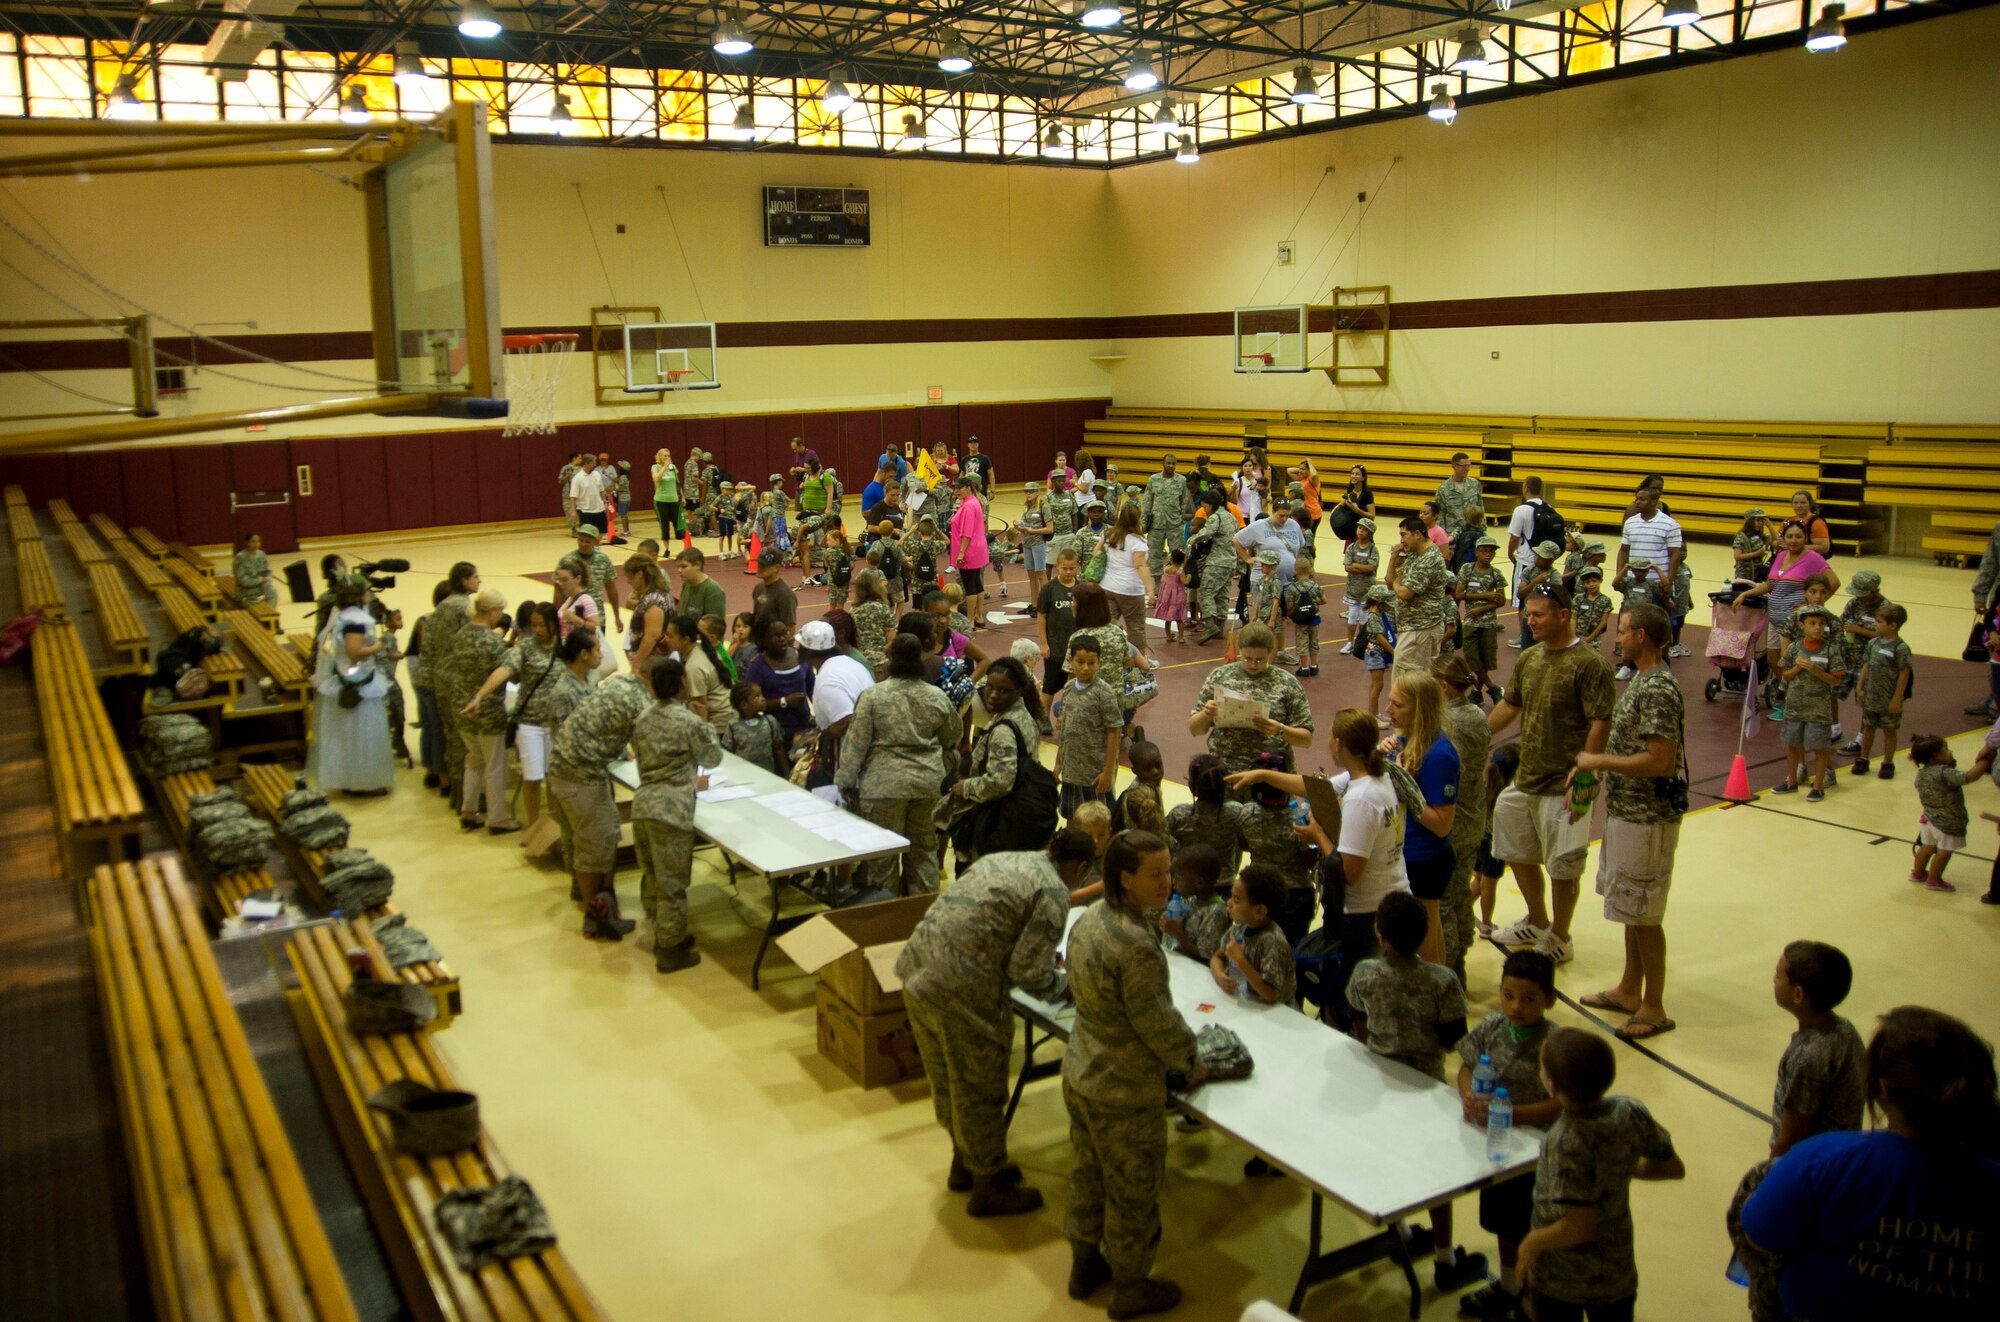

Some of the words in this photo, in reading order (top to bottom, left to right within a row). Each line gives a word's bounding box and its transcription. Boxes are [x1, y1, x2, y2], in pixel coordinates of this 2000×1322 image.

[771, 201, 795, 213] HOME
[844, 202, 867, 214] GUEST
[1878, 1214, 1986, 1255] HOME
[1856, 1240, 1905, 1262] OF
